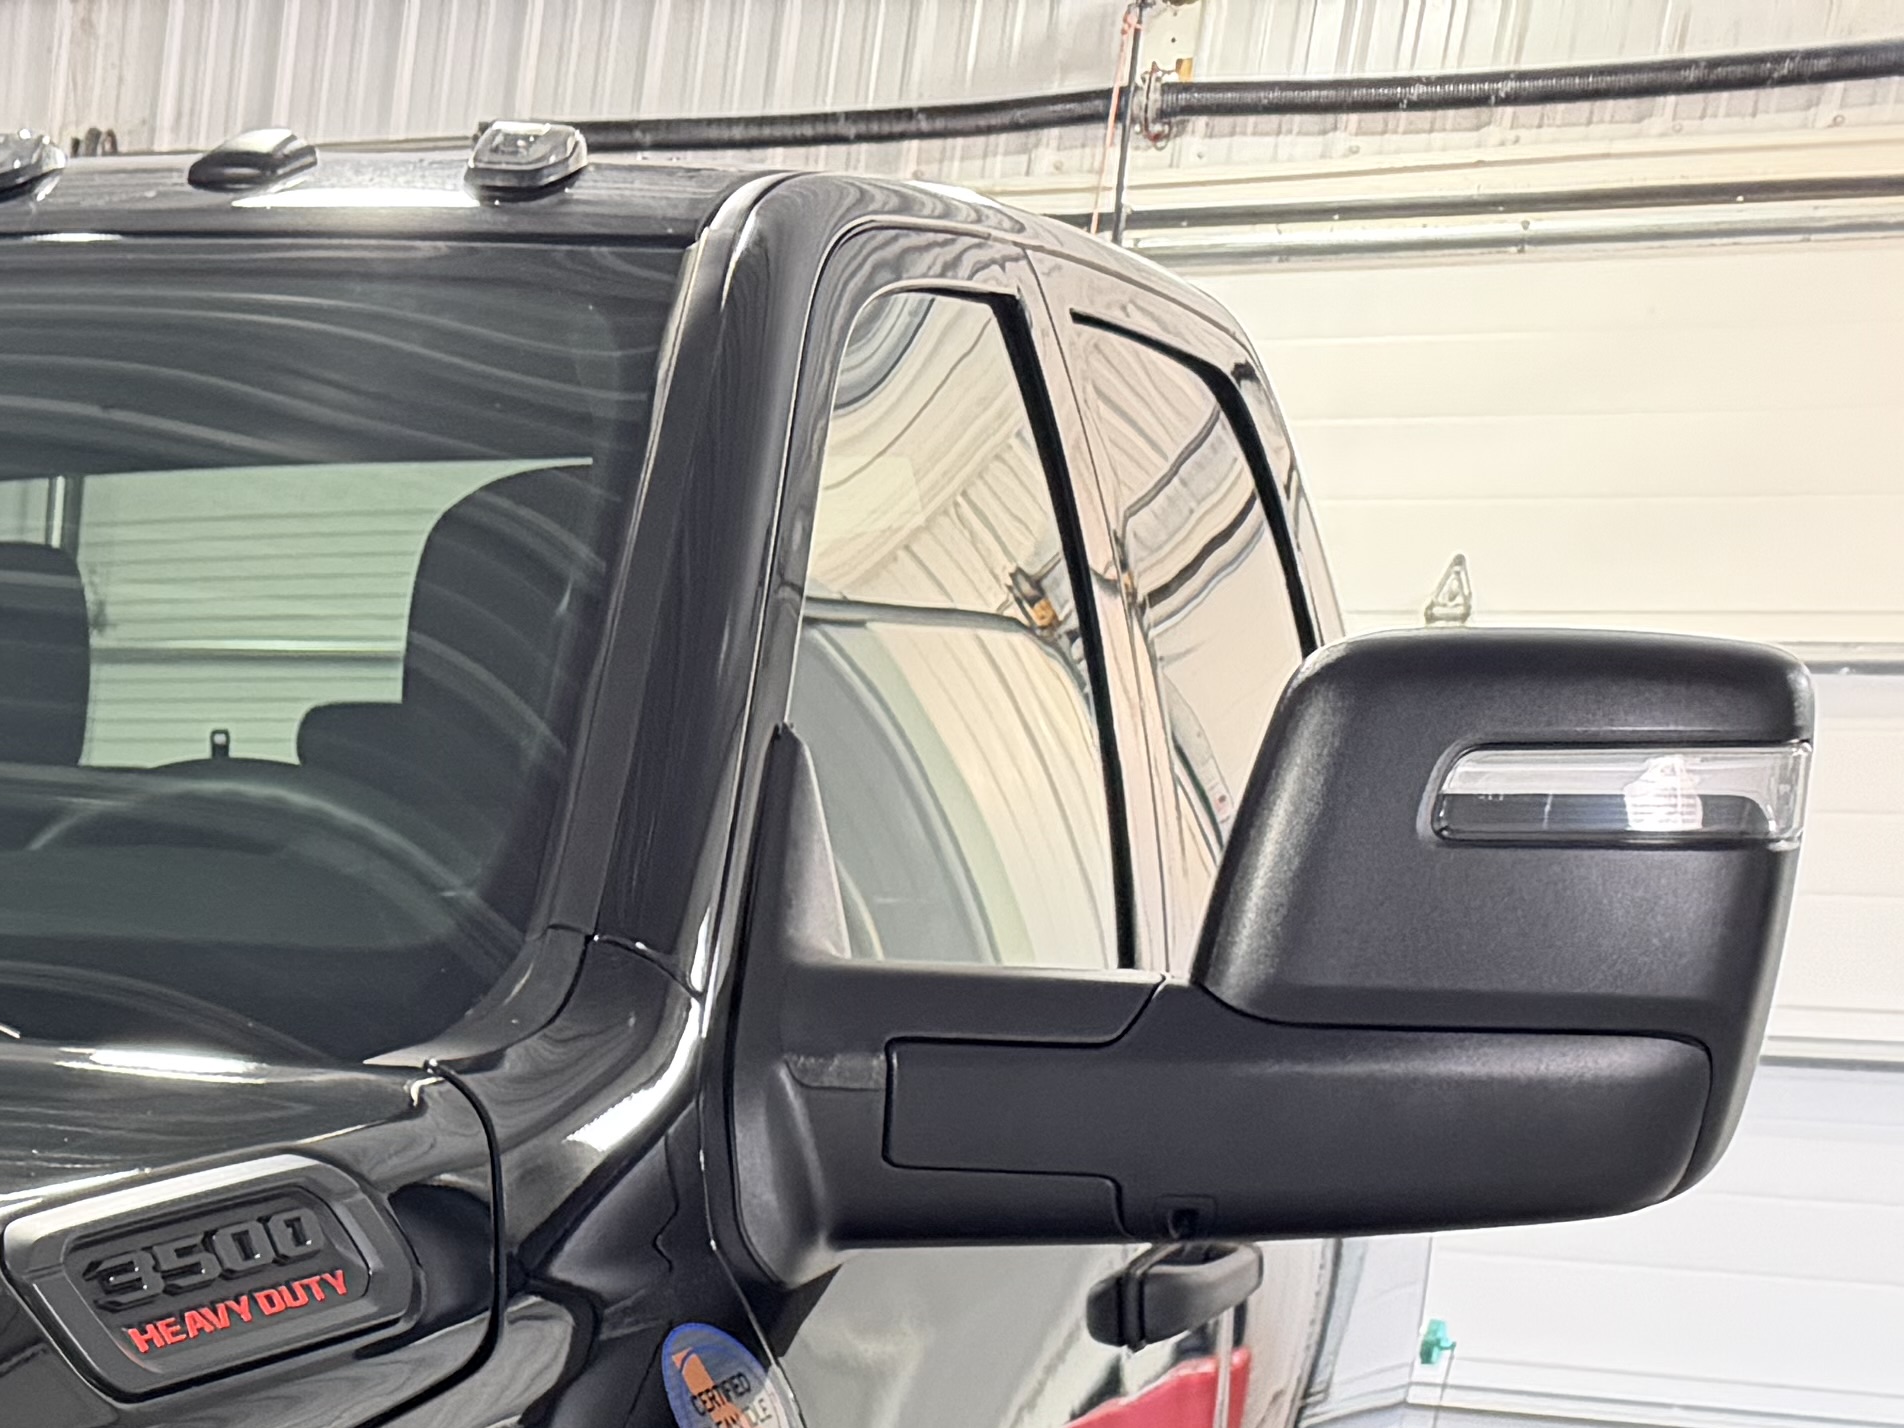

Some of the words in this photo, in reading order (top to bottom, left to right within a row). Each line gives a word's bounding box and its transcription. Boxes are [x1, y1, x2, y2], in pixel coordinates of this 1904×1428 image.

[84, 1207, 328, 1312] 3500
[127, 1294, 253, 1354] HEAVY
[254, 1269, 350, 1318] DUTY
[691, 1371, 752, 1417] CERTIFIED
